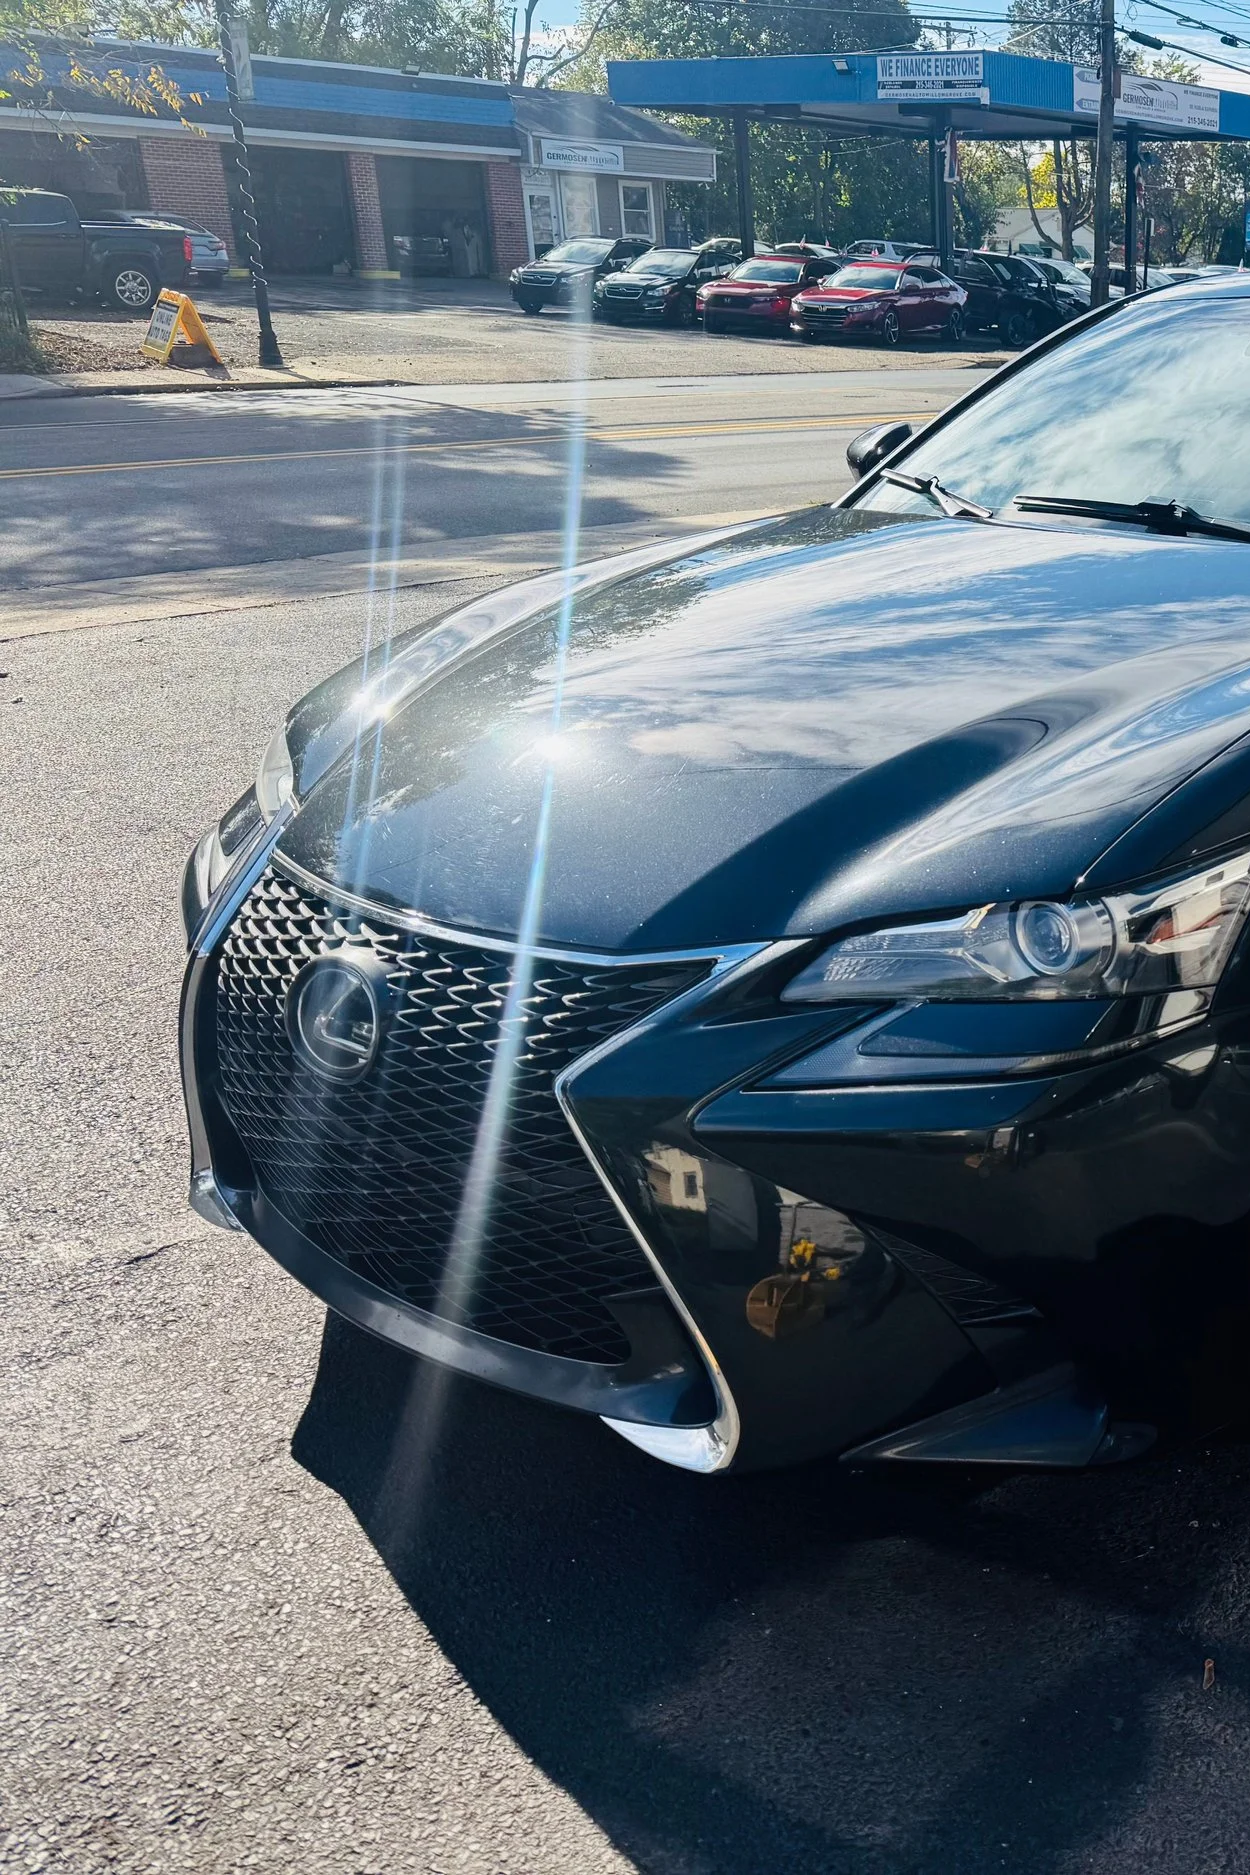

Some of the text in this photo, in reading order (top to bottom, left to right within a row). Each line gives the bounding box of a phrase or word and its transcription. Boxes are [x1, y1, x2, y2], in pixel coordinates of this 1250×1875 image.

[880, 56, 980, 77] WE FINANCE EVERYONE
[1122, 93, 1154, 107] GERMOSEN
[546, 152, 587, 162] GERMOSEN
